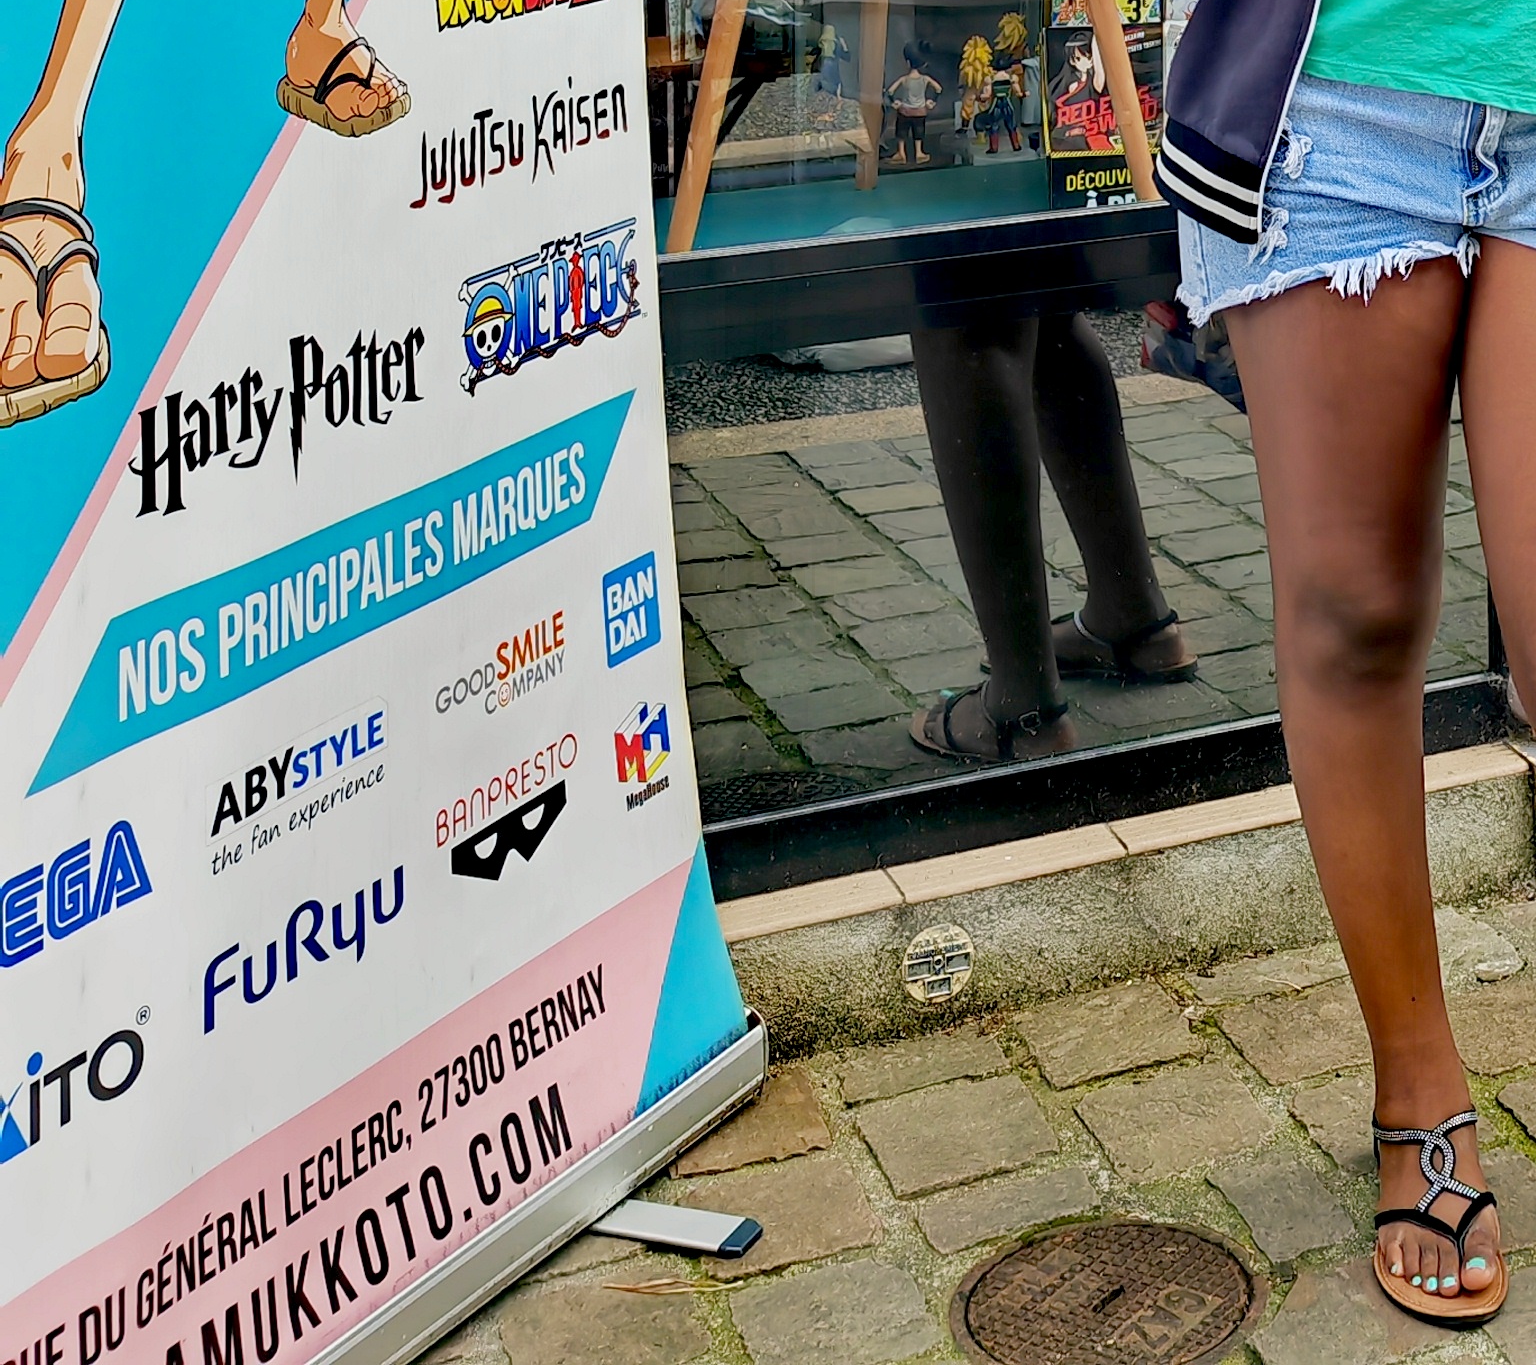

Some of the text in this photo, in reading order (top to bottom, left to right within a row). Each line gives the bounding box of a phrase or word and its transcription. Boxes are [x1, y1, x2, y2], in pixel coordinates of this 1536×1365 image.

[410, 107, 524, 210] JUJUTSU
[129, 326, 426, 519] Harry Potter
[117, 441, 587, 723] NOS PRINCIPALES MARQUES
[607, 564, 655, 620] BAN
[609, 606, 648, 656] DAI
[435, 609, 565, 715] GOOD SMILE
[484, 648, 565, 715] COMPANY
[210, 707, 386, 837] ABYSTYLE
[211, 761, 386, 877] the fan experience
[436, 731, 578, 849] BANPRESTO
[78, 1286, 127, 1365] DU
[136, 1197, 277, 1329] GÉNÉRAL
[284, 1106, 413, 1227] LECLERC,
[418, 1034, 504, 1130] 27300
[511, 963, 608, 1068] BERNAY
